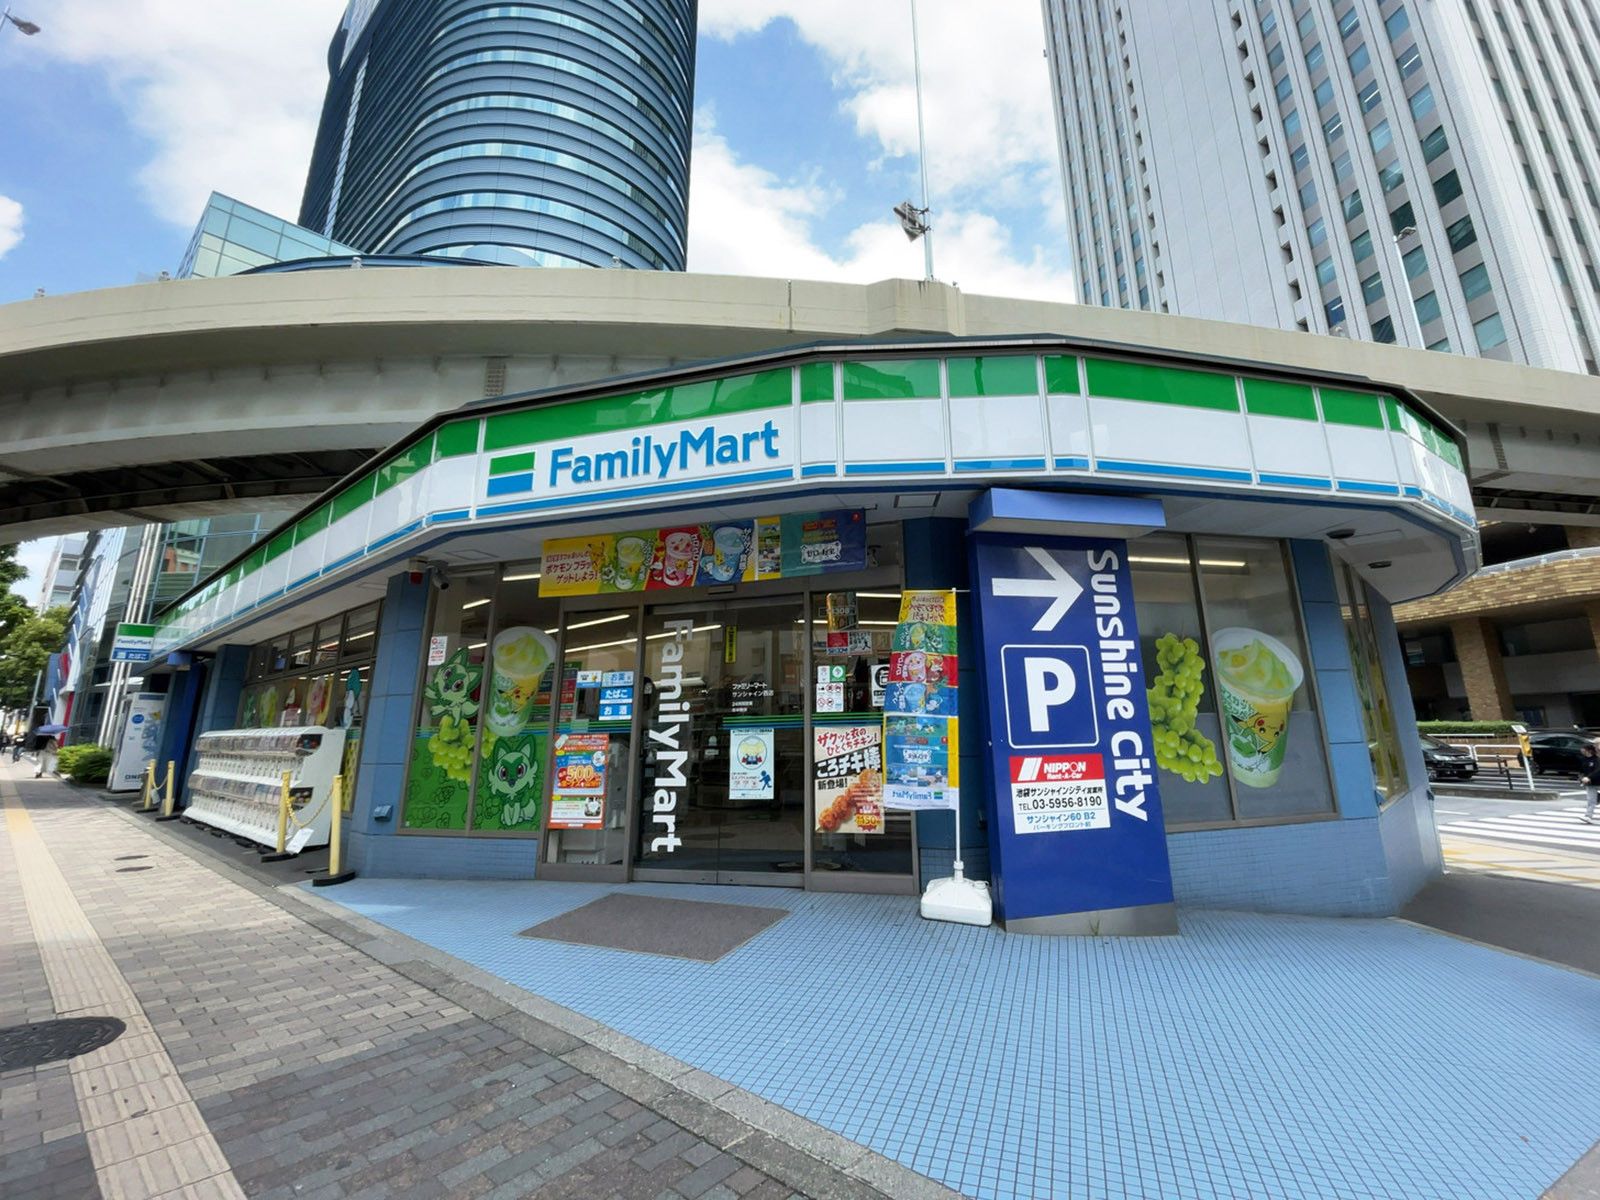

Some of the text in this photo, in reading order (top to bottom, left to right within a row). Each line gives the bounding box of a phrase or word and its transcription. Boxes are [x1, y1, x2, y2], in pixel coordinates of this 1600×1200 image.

[550, 420, 779, 487] FamilyMart
[732, 682, 768, 690] ファミリーマート
[1087, 550, 1153, 822] Sunshine City
[605, 689, 628, 699] たばこ
[1024, 656, 1077, 733] P
[649, 619, 694, 853] FamilyMart
[817, 728, 867, 747] ザクッと衣の
[826, 733, 878, 756] ひとくちチキン!
[817, 746, 881, 777] ころチキ棒
[1043, 761, 1087, 774] NIPPON
[567, 765, 594, 780] 500
[1046, 772, 1083, 780] Rent-A-Car
[818, 778, 848, 790] 新登場!
[1016, 786, 1103, 798] 池袋サンシャインシティ営業所
[1027, 811, 1096, 824] サンシャイン60 B2
